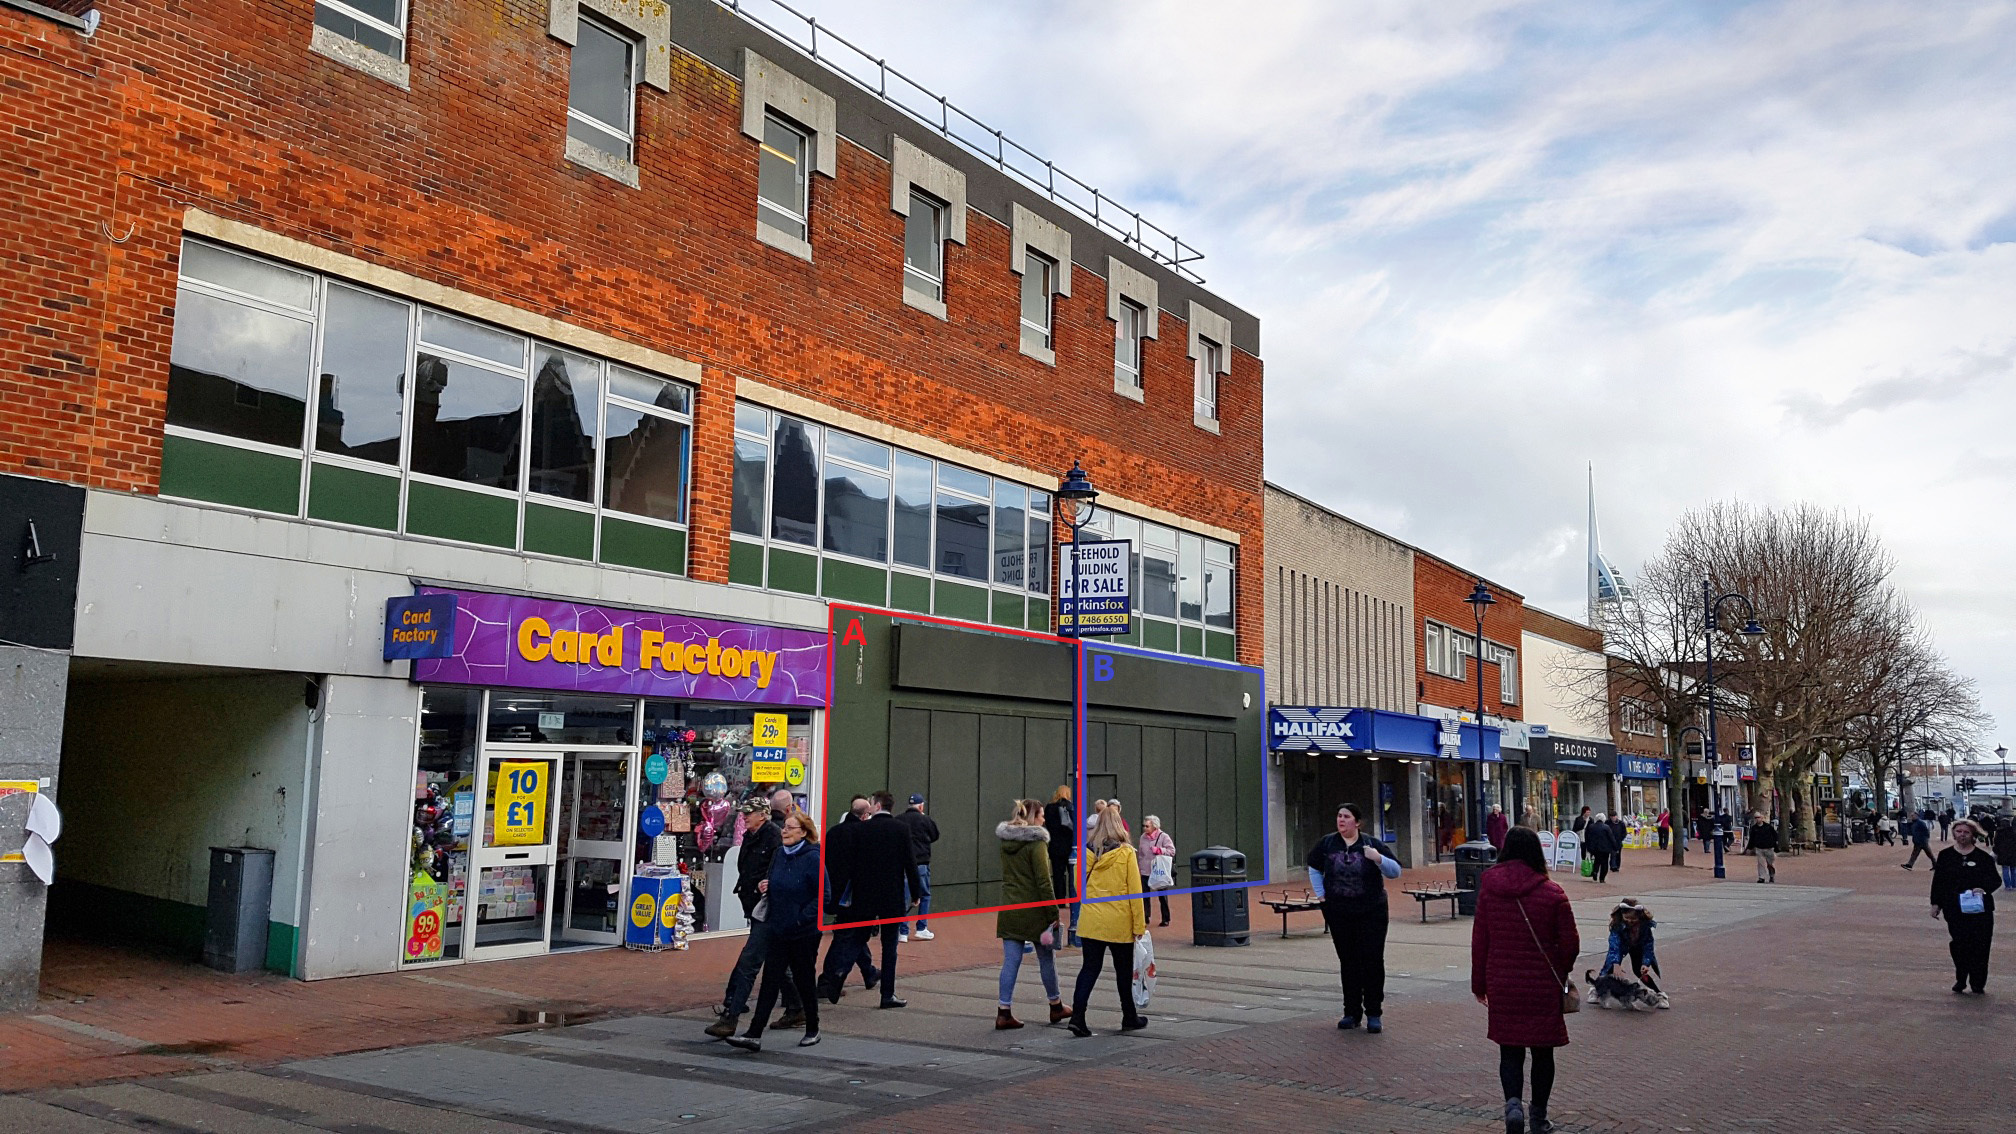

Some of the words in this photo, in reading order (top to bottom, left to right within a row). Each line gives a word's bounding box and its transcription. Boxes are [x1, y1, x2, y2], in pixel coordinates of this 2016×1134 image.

[1070, 548, 1119, 560] EEHOLD
[1064, 579, 1089, 594] FR
[1093, 578, 1124, 593] SALE
[402, 609, 432, 625] Card
[1081, 616, 1101, 624] 7486
[1103, 615, 1124, 624] 6550
[392, 628, 438, 645] Factory
[517, 616, 623, 668] Card
[639, 628, 777, 689] Factory
[762, 724, 779, 738] 29p
[1274, 722, 1354, 737] HALIFAX
[1440, 732, 1461, 746] HALIFAX
[764, 750, 768, 759] 4
[774, 750, 783, 760] £1
[1554, 742, 1598, 758] PEACOCKS
[790, 768, 801, 778] 29p
[508, 769, 538, 794] 10
[507, 802, 534, 826] £1
[418, 916, 436, 933] 99p
